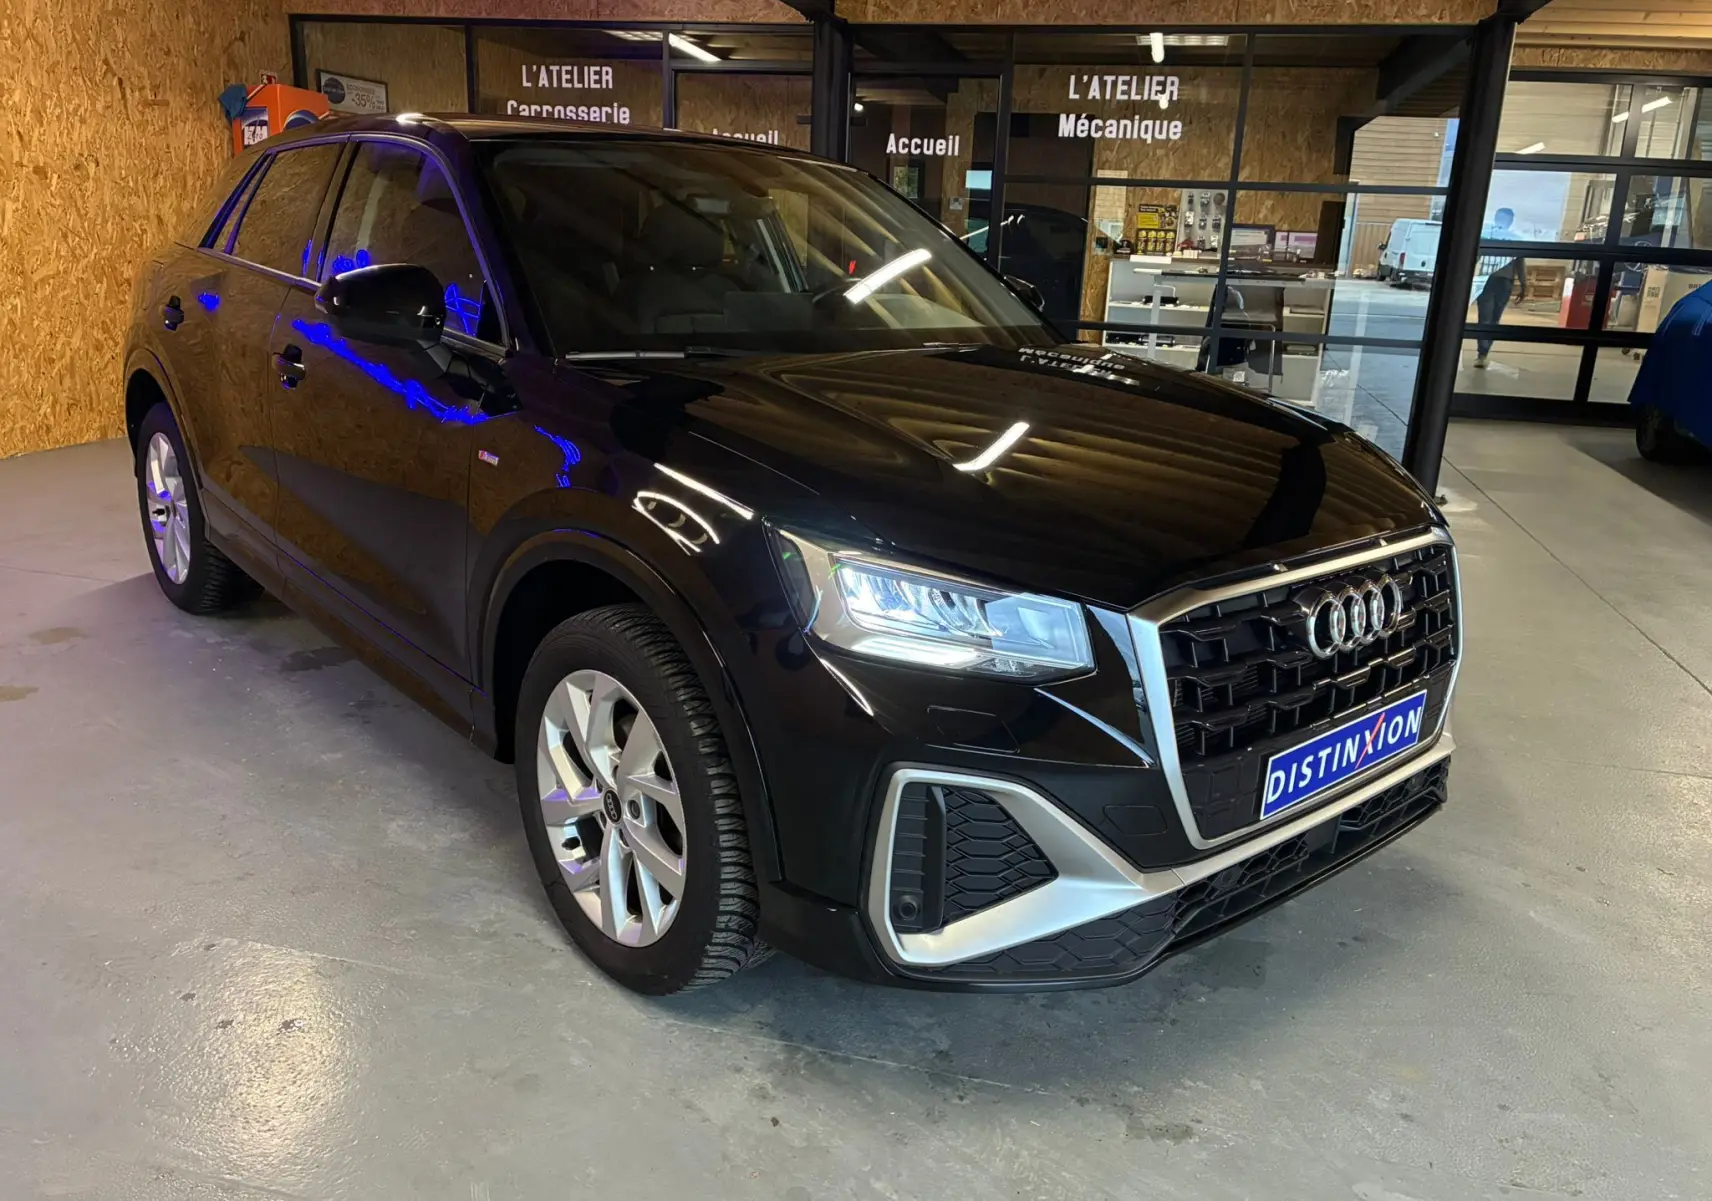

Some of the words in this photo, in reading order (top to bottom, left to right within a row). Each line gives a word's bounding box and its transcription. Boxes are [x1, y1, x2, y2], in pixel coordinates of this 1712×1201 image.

[521, 65, 613, 89] L'ATELIER
[1068, 75, 1179, 101] L'ATELIER
[506, 100, 630, 125] Carrosserie
[1058, 113, 1182, 144] Mécanique
[886, 133, 960, 156] Accueil
[1266, 706, 1422, 804] DISTINXION
